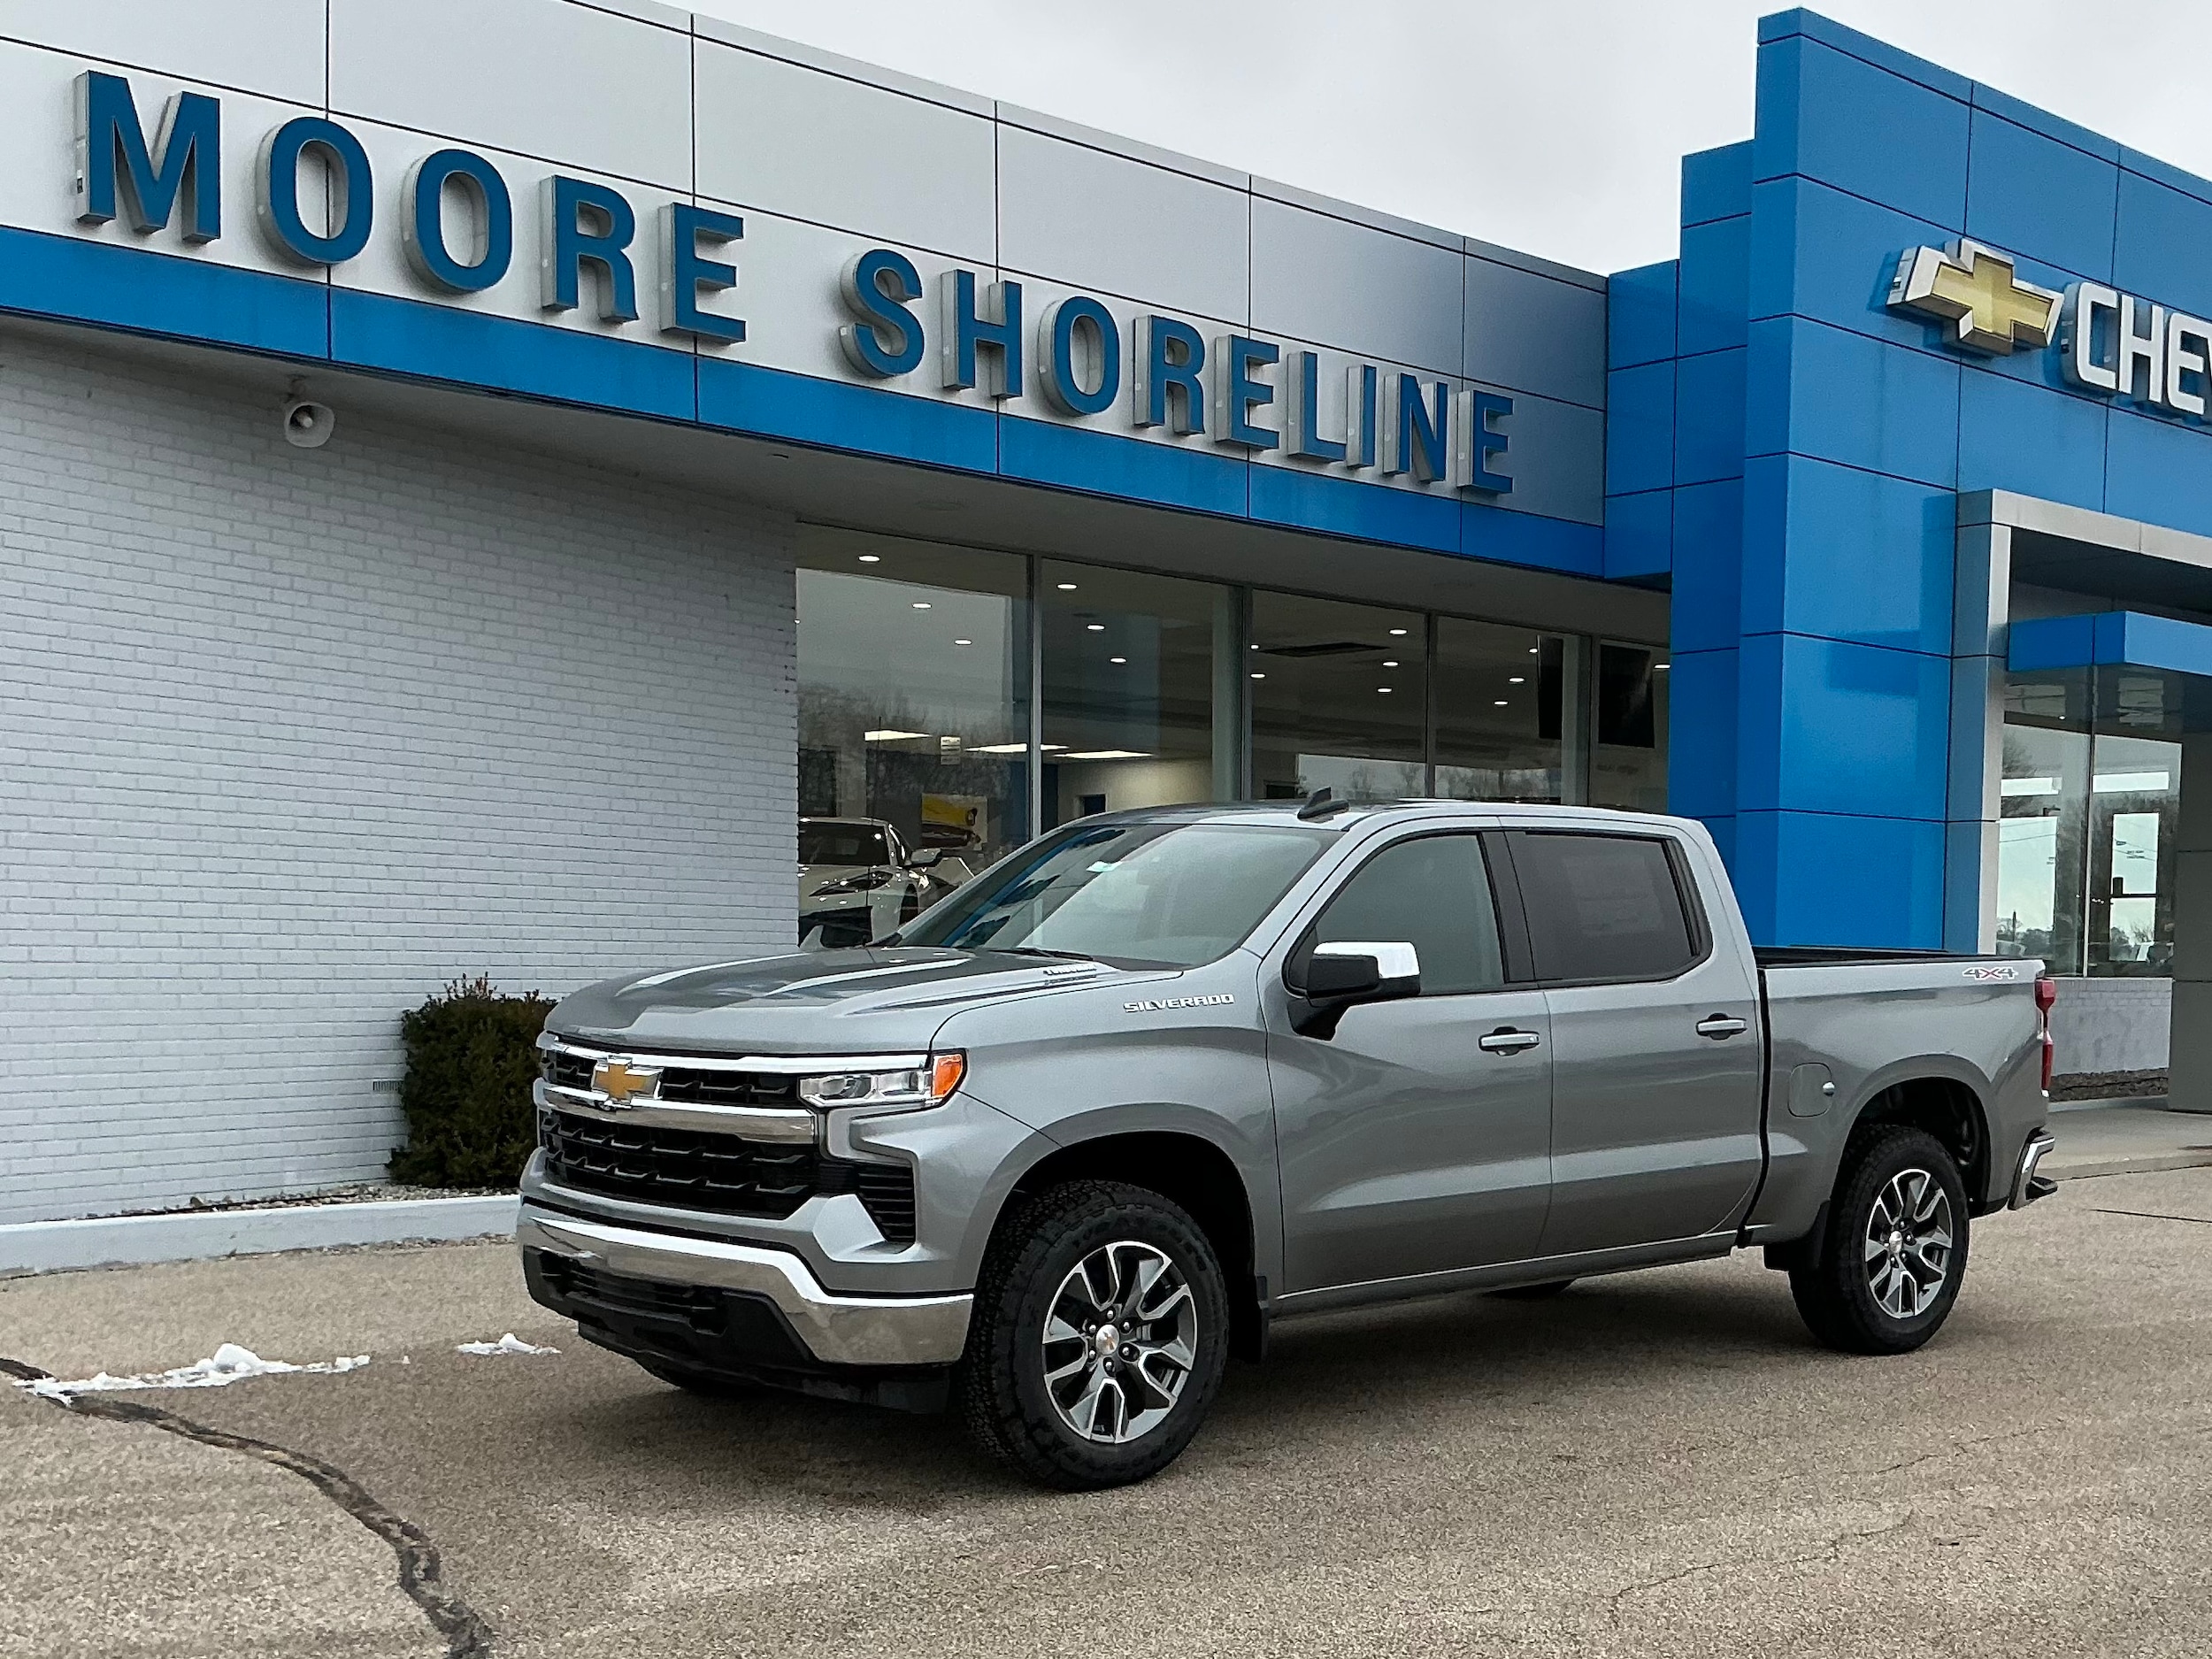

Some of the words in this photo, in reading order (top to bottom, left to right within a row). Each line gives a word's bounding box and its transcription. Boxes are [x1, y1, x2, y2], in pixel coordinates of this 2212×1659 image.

[76, 70, 747, 344] MOORE
[841, 249, 1514, 495] SHORELINE
[2076, 281, 2212, 415] CHE
[1123, 994, 1235, 1013] SILVERADO
